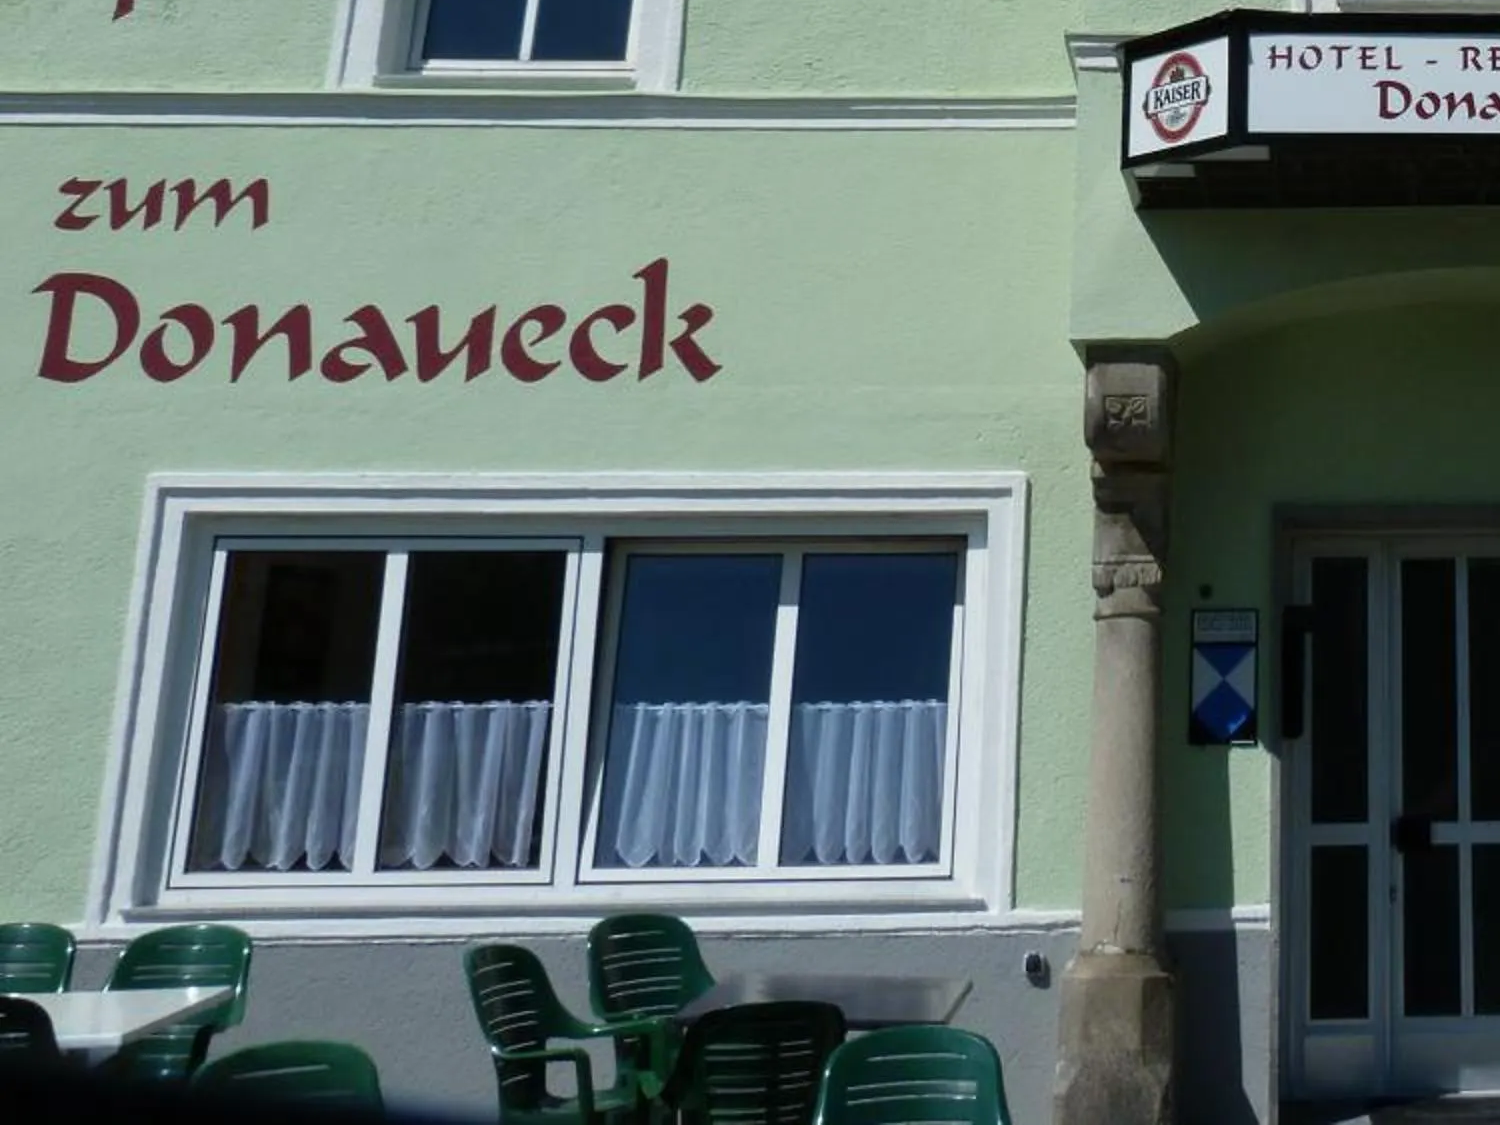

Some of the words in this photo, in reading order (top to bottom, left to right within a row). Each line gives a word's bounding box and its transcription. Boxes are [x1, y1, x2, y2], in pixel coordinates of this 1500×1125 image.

[1268, 45, 1403, 70] HOTEL
[1153, 80, 1201, 110] KAISER
[53, 176, 270, 231] zum
[30, 257, 723, 383] Donaueck
